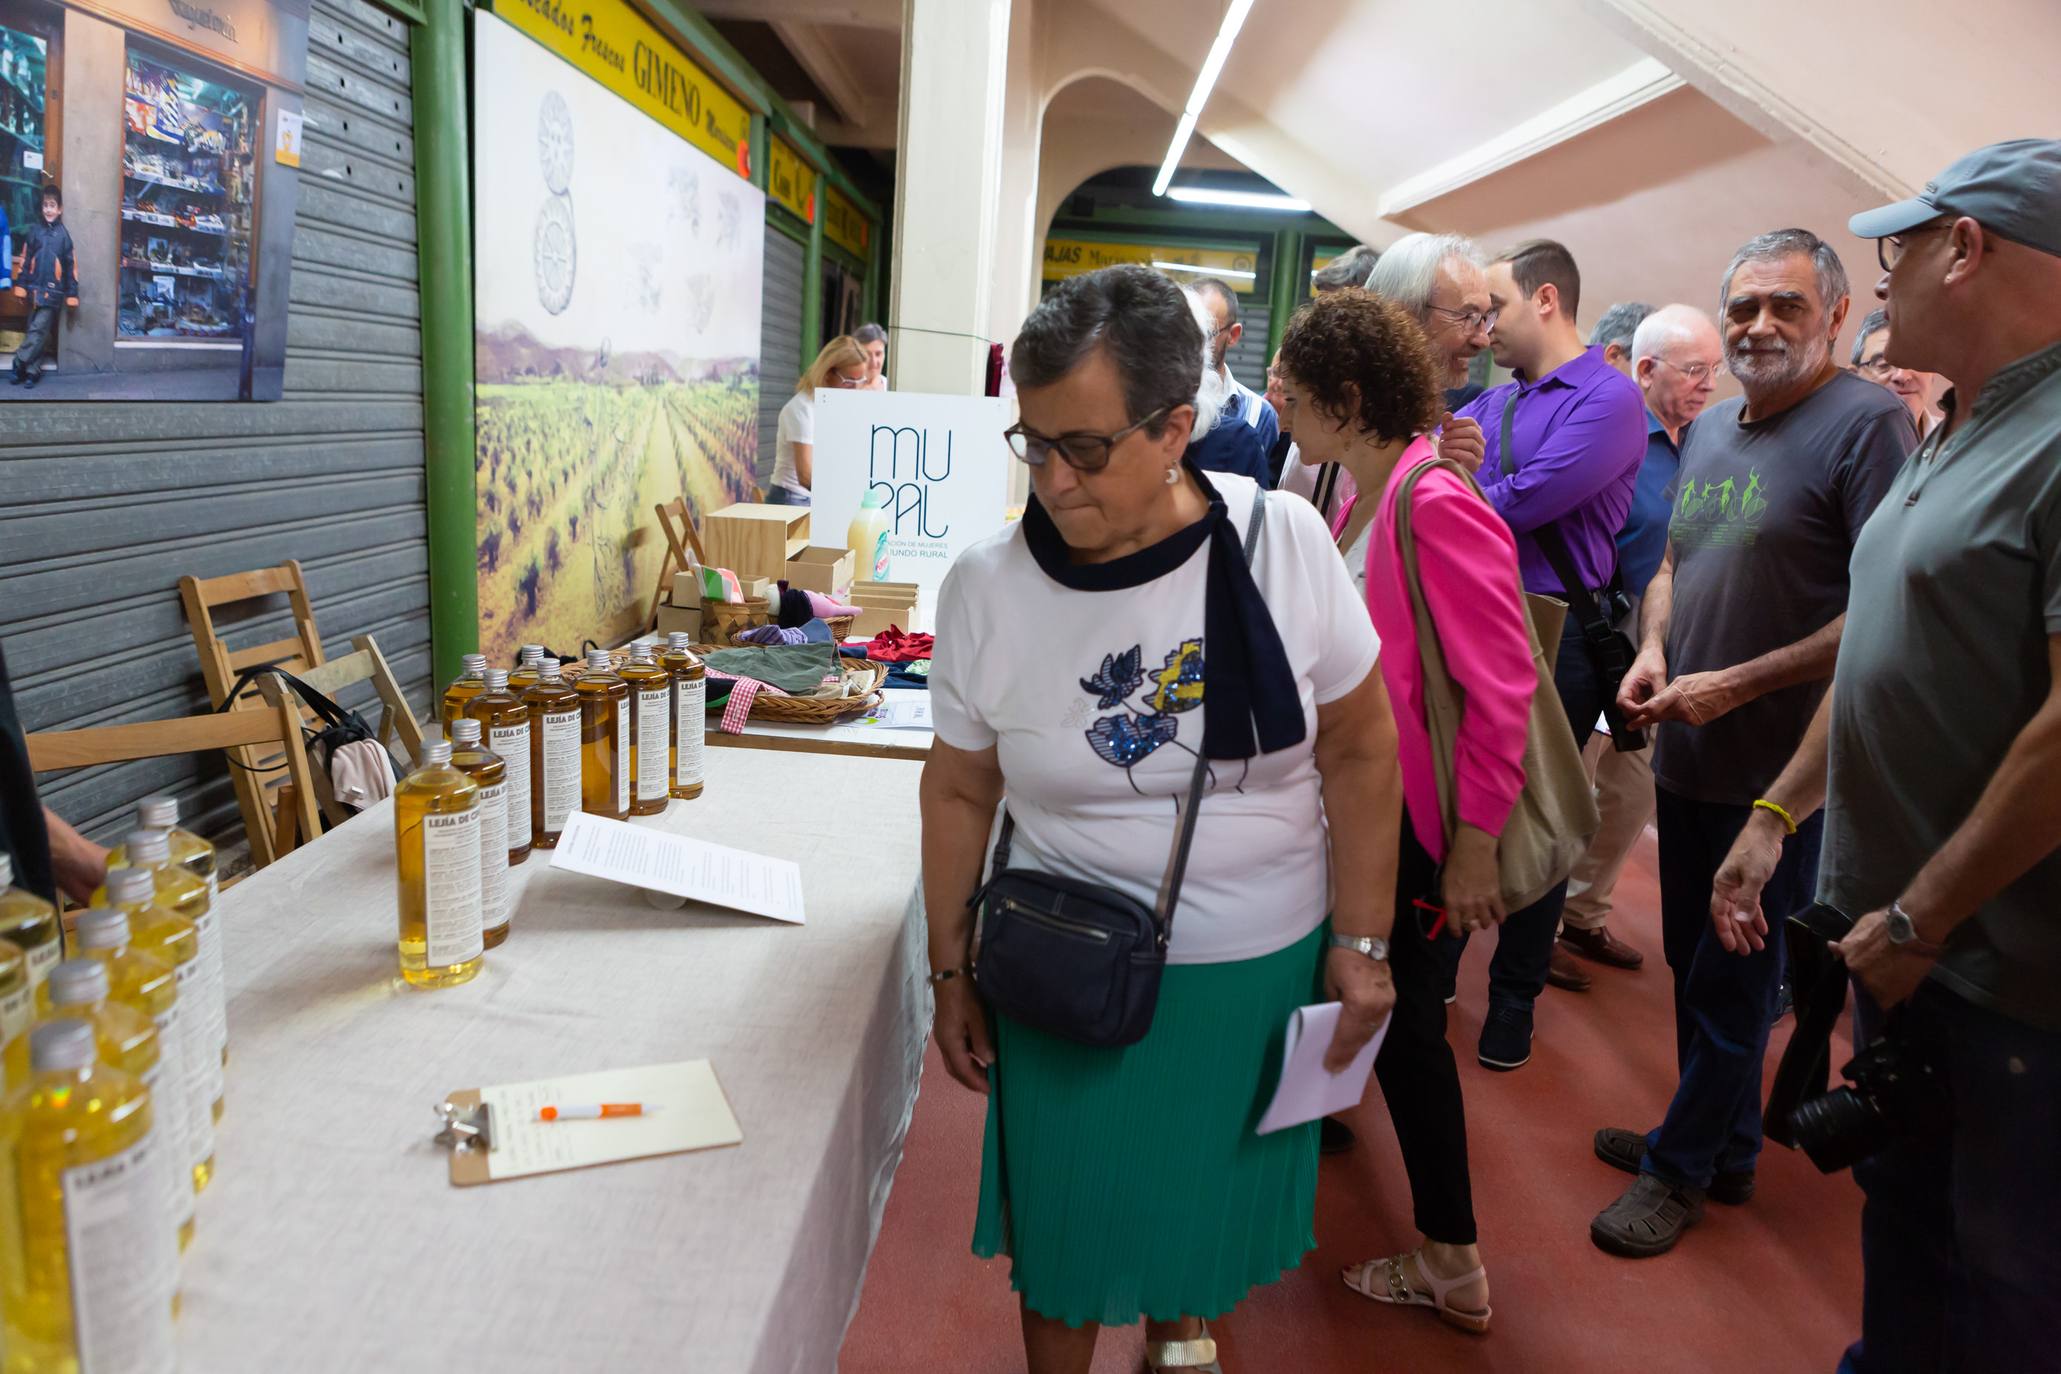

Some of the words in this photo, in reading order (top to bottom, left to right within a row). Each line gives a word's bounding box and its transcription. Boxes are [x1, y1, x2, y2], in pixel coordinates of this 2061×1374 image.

[581, 14, 625, 74] Frescos
[634, 40, 701, 128] GIMENO
[1044, 245, 1082, 264] AJAS
[889, 548, 918, 557] UNDO
[919, 550, 949, 559] RURAL
[918, 542, 949, 550] MUJERES
